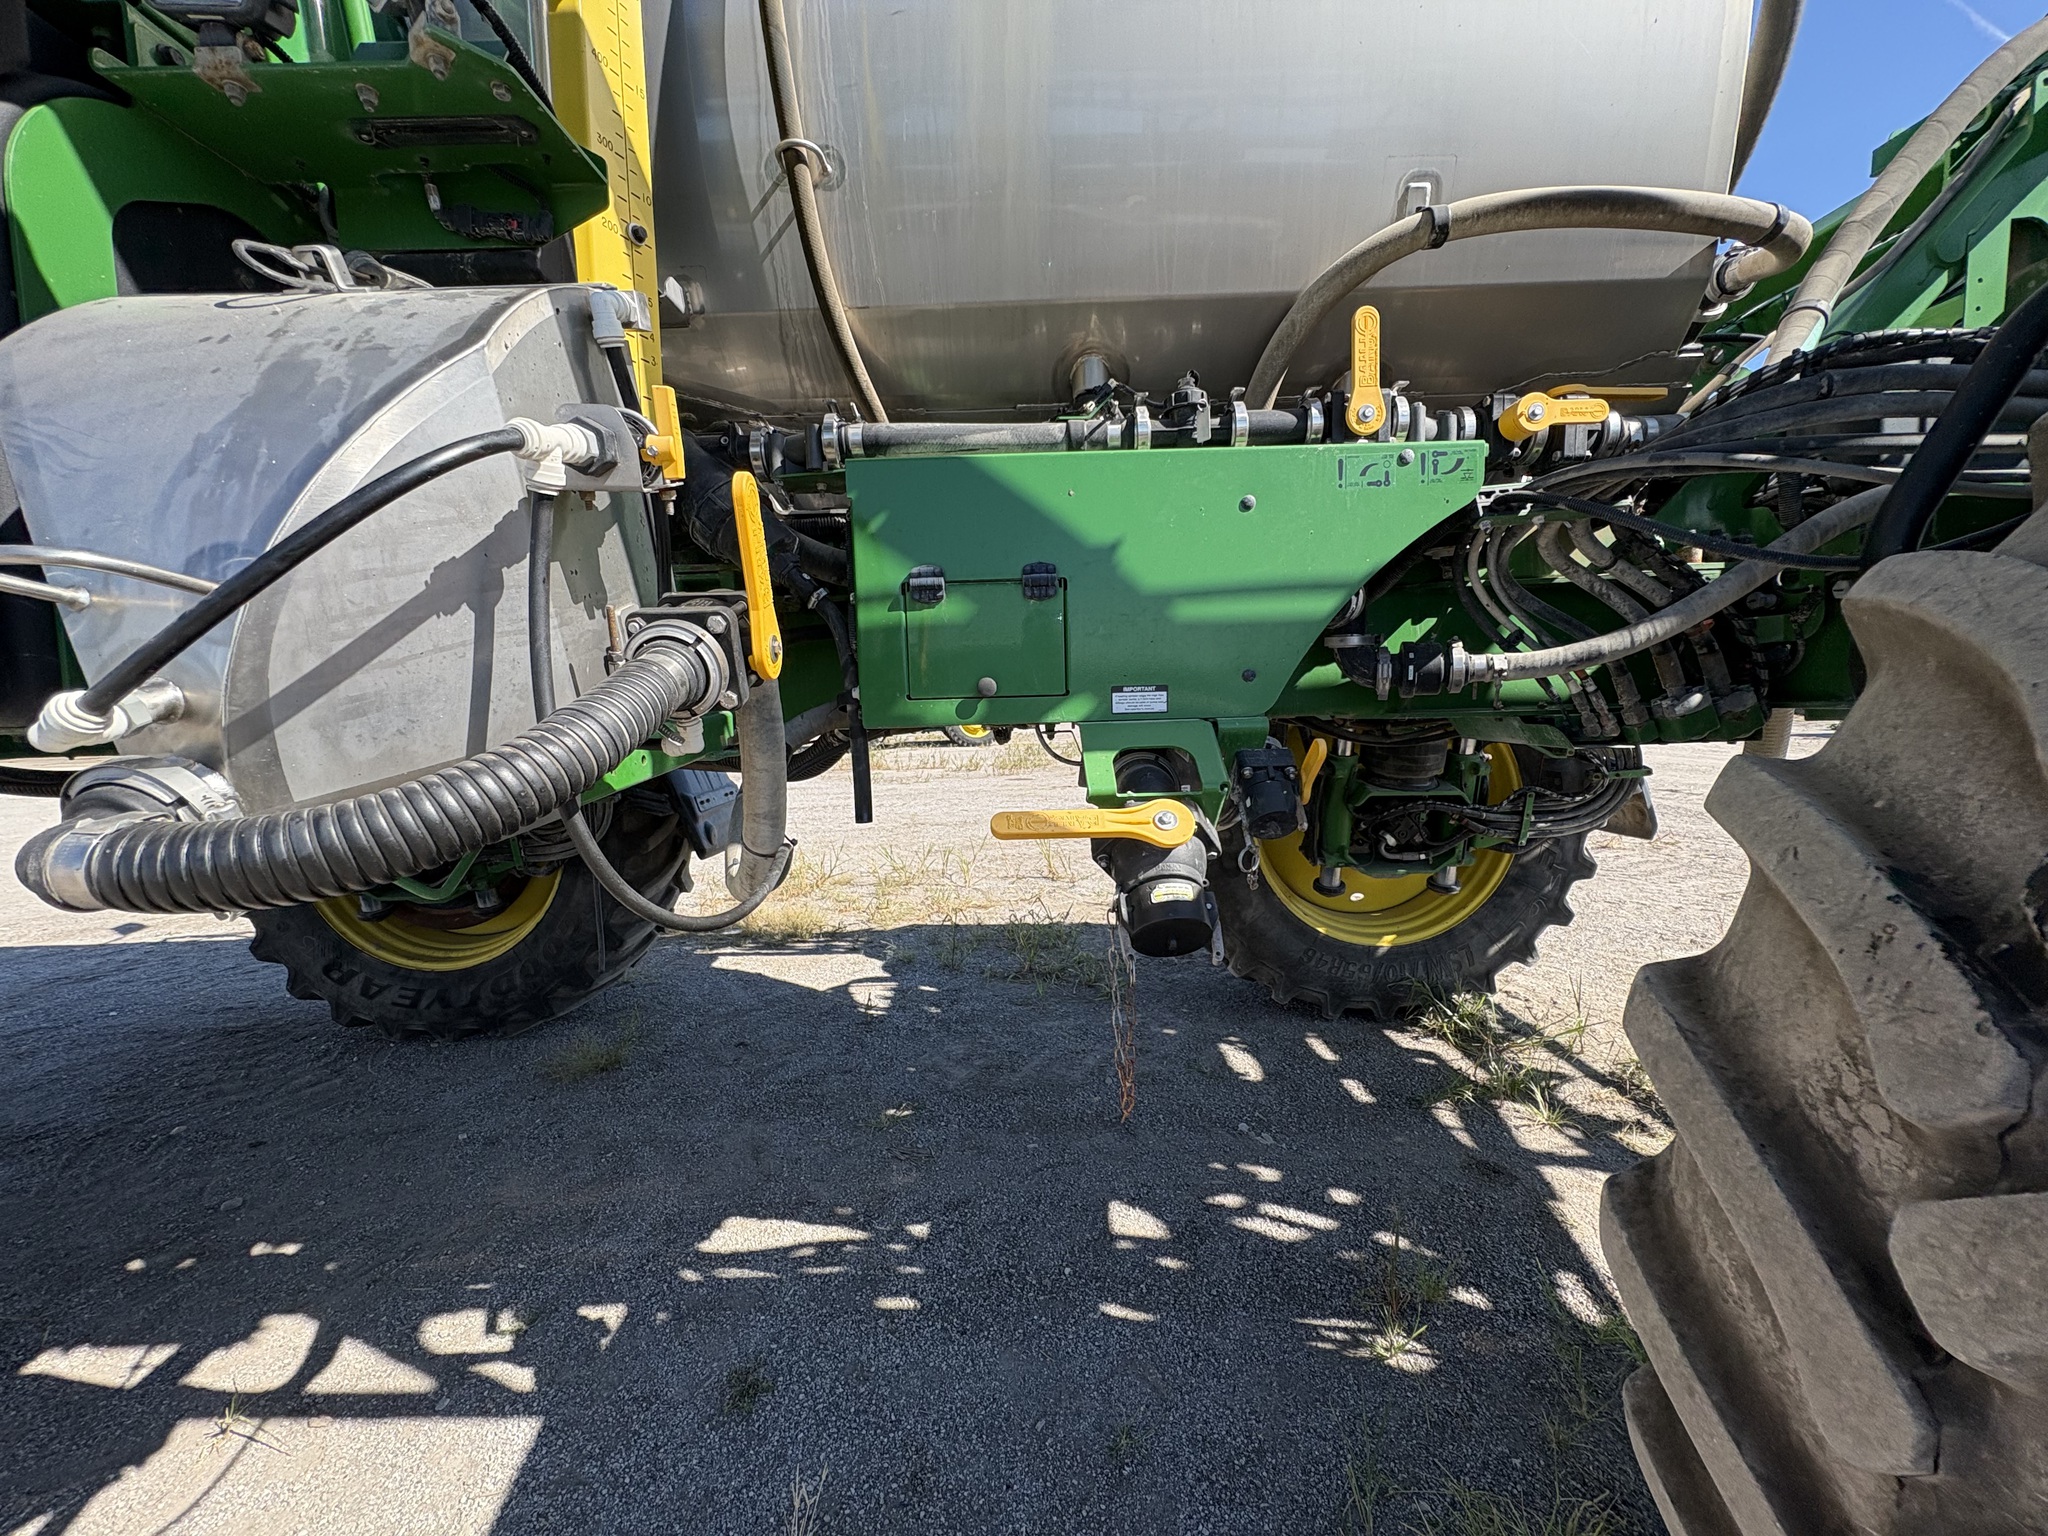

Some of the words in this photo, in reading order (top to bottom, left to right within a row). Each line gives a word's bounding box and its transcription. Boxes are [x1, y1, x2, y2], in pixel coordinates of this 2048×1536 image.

[591, 47, 608, 67] 400
[635, 85, 645, 99] 15
[596, 132, 614, 153] 300
[642, 192, 652, 206] 10
[601, 216, 618, 235] 200
[650, 355, 657, 366] 3
